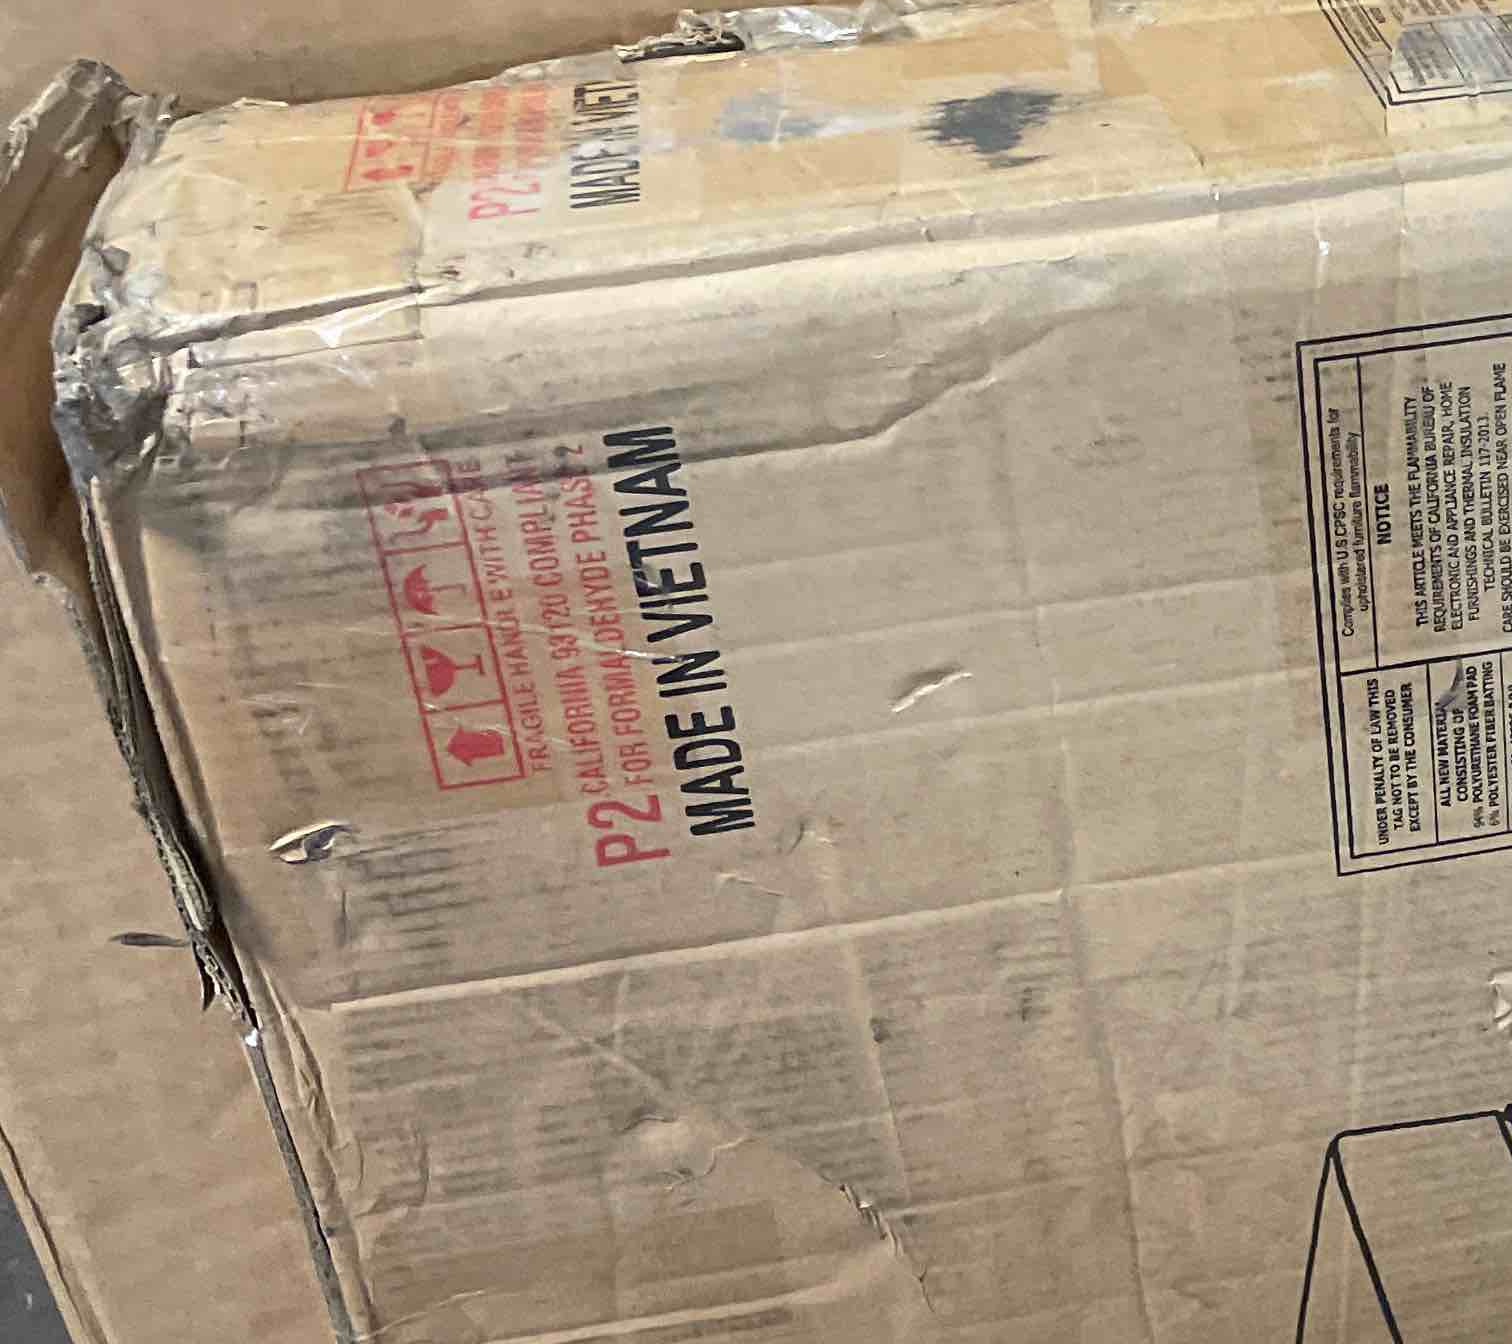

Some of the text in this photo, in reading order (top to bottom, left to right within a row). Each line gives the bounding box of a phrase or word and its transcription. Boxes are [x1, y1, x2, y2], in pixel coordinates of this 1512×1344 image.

[568, 78, 640, 125] VIET
[1421, 384, 1434, 403] OF
[1439, 380, 1453, 417] HOME
[1492, 362, 1506, 401] FLAME
[1494, 403, 1507, 436] OPEN
[1495, 438, 1508, 469] NEAR
[1373, 482, 1392, 545] NOTICE
[1408, 482, 1421, 507] THE
[1424, 454, 1440, 524] CALIFORNIA
[1443, 468, 1458, 531] APPLIANCE
[1457, 385, 1480, 621] FURNISHINGS AND THERMAL INSULATION
[1479, 470, 1493, 525] BULLETIN
[1497, 471, 1511, 536] EXERCISED
[475, 526, 510, 583] WITH
[1410, 509, 1423, 548] MEETS
[1428, 525, 1441, 543] OF
[1447, 533, 1460, 559] AND
[1499, 538, 1511, 553] BE
[1482, 527, 1496, 591] TECHNICAL
[1500, 554, 1512, 601] SHOULD
[1415, 599, 1428, 627] THIS
[1429, 544, 1447, 632] REQUIREMENTS
[1448, 560, 1463, 631] ELECTRONIC
[602, 427, 755, 837] MADE IN VIETNAM
[1466, 665, 1477, 687] PAD
[515, 681, 552, 773] FRAGILE
[554, 665, 609, 794] CALIFORNIA
[1384, 688, 1398, 744] REMOVED
[617, 741, 654, 786] FOR
[1366, 677, 1389, 845] UNDER PENALTY OF LAW THIS
[1389, 764, 1400, 779] TO
[1400, 681, 1420, 832] EXCEPT BY THE CONSUMER
[1434, 699, 1451, 808] ALL NEW MATERIA
[1453, 726, 1468, 802] CONSISTING
[1486, 744, 1498, 807] POLYESTER
[1390, 781, 1401, 805] NOT
[1392, 807, 1403, 830] TAG
[587, 795, 672, 867] P2
